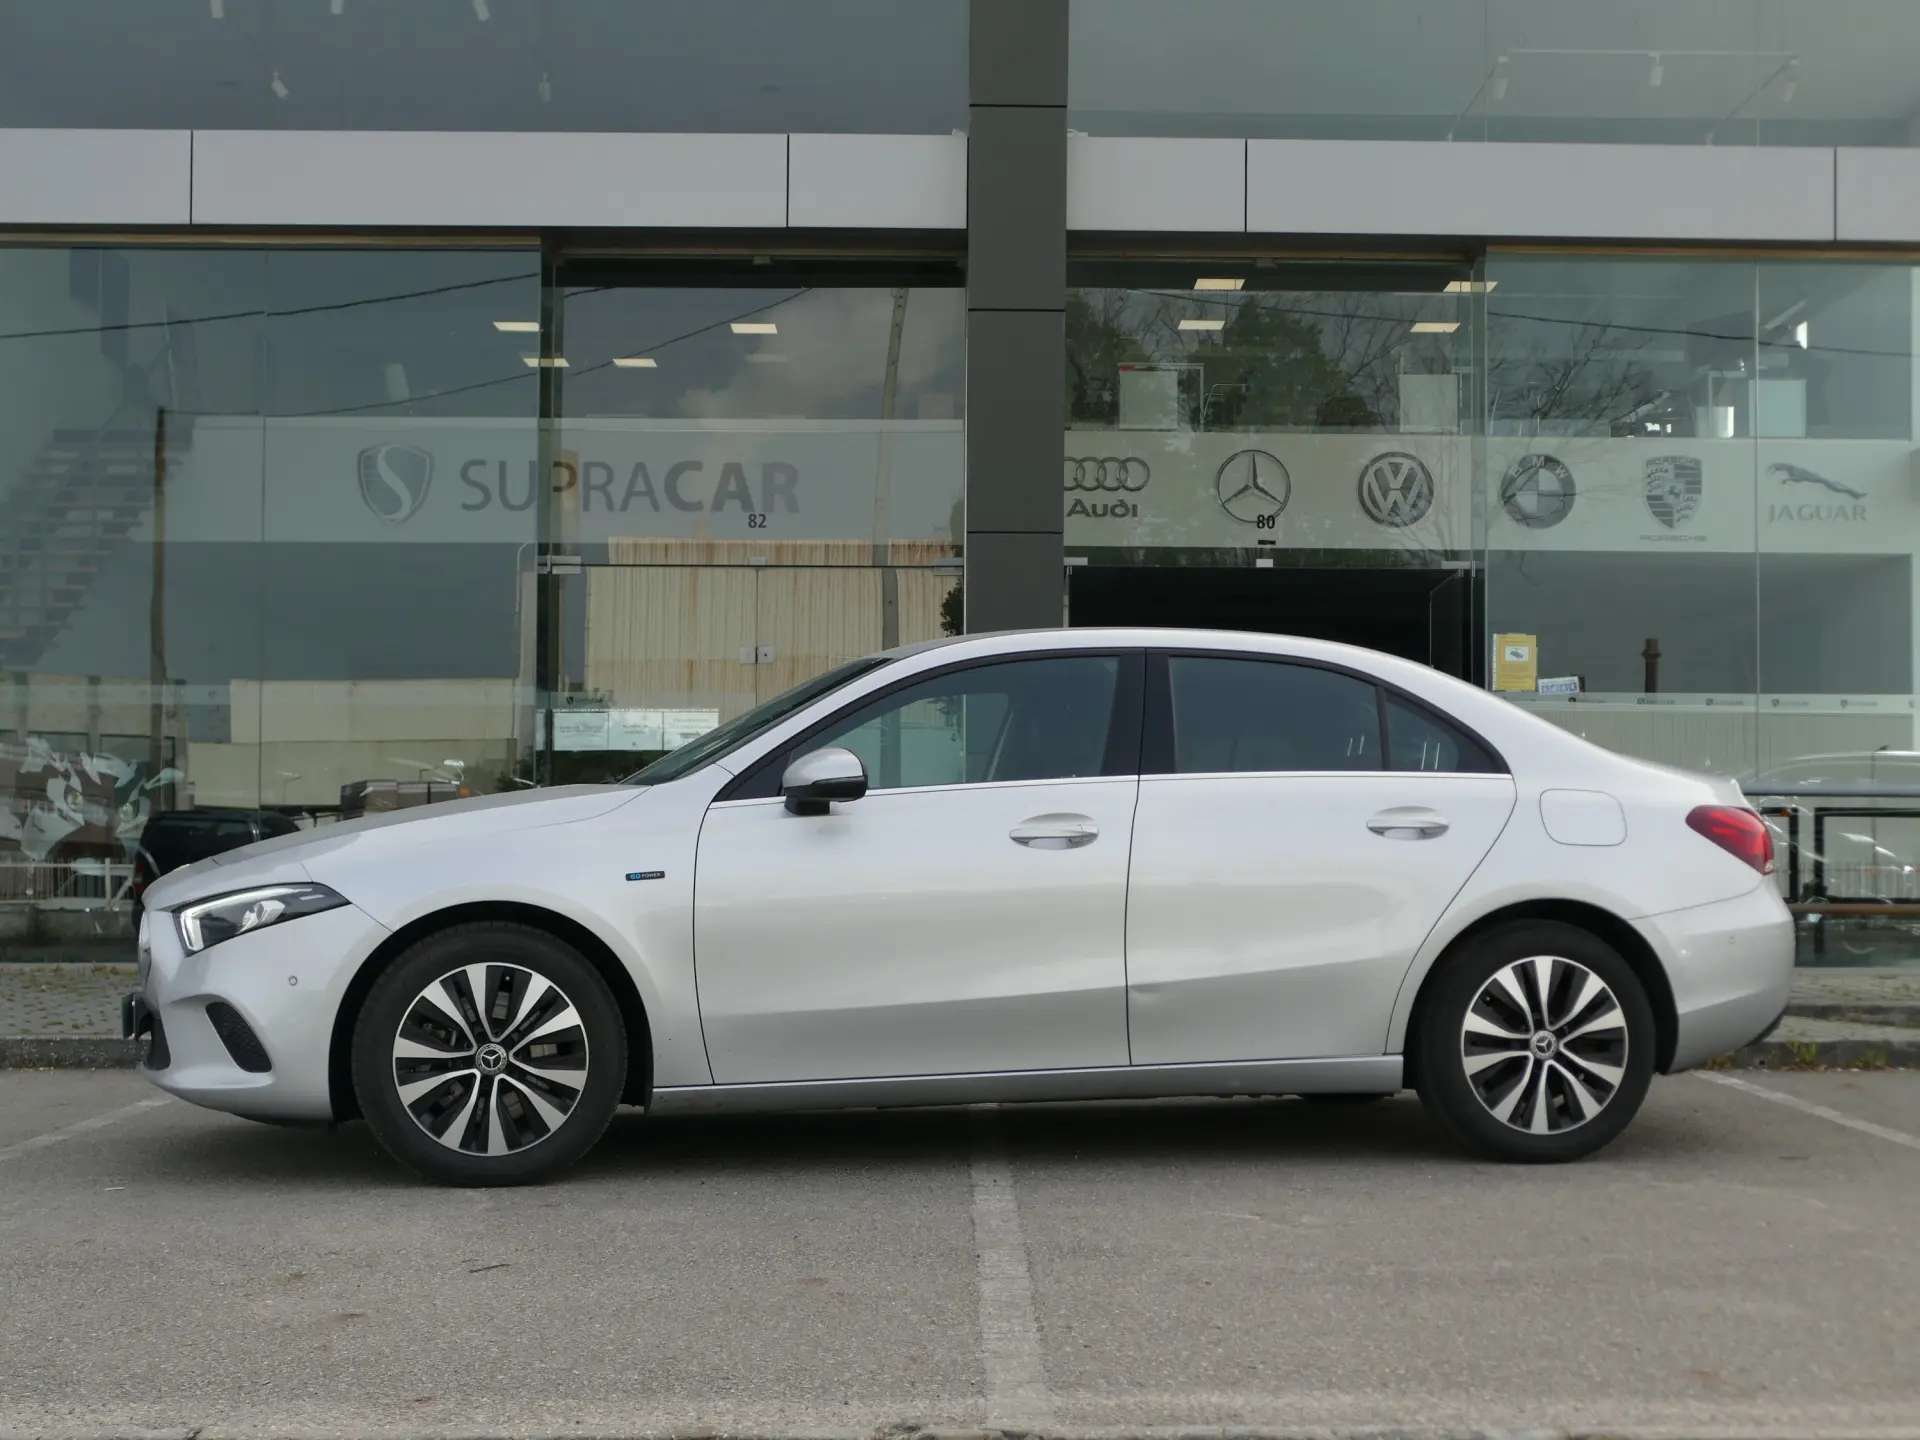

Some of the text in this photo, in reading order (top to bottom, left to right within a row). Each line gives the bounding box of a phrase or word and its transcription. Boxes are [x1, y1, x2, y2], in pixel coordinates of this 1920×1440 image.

[459, 458, 800, 513] SUPRACAR
[1065, 498, 1139, 518] Audi
[1765, 503, 1868, 525] JAGUAR
[747, 513, 768, 529] 82
[1256, 514, 1276, 529] 80
